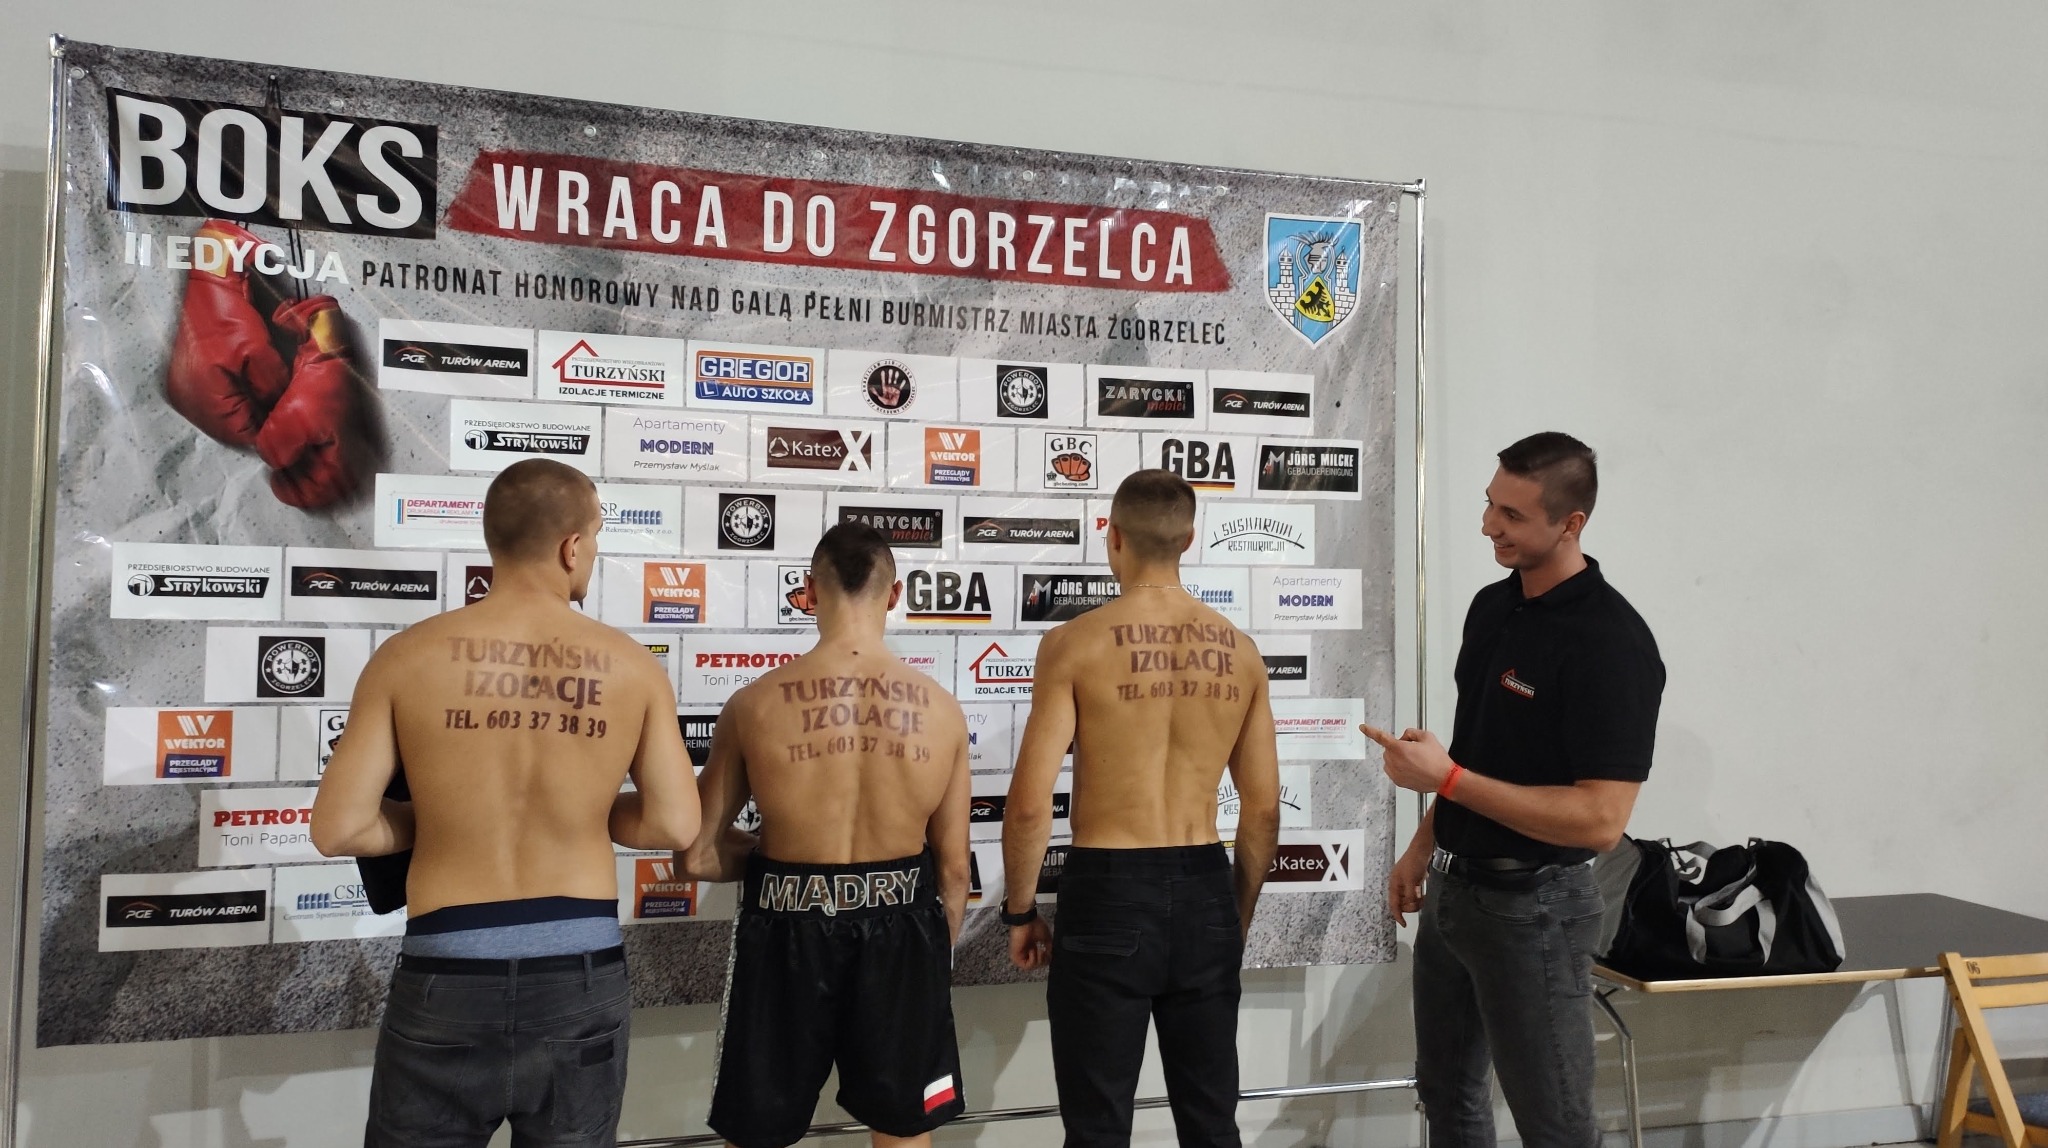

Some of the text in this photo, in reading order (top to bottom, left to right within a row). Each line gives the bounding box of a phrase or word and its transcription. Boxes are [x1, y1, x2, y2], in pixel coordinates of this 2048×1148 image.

[115, 95, 424, 229] BOKS
[492, 163, 1193, 285] WRACA DO ZGORZELCA
[125, 232, 350, 285] II EDYCJA
[362, 260, 502, 296] PATRONAT
[515, 272, 660, 308] HONOROWY
[671, 285, 720, 313] NAD
[732, 289, 792, 322] GALĄ
[804, 293, 870, 323] PEŁNI
[882, 300, 1009, 333] BURMISTRZ
[1020, 310, 1097, 339] MIASTA
[400, 353, 521, 370] PGE TURÓW ARENA
[700, 357, 810, 382] GREGOR
[571, 364, 665, 382] TURZYŃSKI
[1003, 371, 1042, 390] POWERBOX
[559, 387, 665, 400] IZOLACJE TERMICZNE
[722, 387, 811, 402] AUTO SZKOŁA
[1105, 385, 1182, 402] ZARYCKI
[1225, 400, 1305, 411] PGE TURÓW ARENA
[542, 423, 592, 432] BUDOWLANE
[633, 417, 726, 435] Apartamenty
[640, 438, 714, 455] MODERN
[792, 440, 842, 458] Katex
[1050, 437, 1092, 455] GBC
[930, 451, 975, 462] WEKTOR
[1161, 438, 1235, 480] GBA
[1287, 451, 1354, 467] JÖRG MILCKE
[633, 461, 720, 473] Przemysław Myślak
[407, 499, 475, 509] DEPARTAMENT
[600, 502, 619, 517] SR
[726, 500, 769, 519] POWERBOX
[976, 527, 1075, 539] PGE TURÓW ARENA
[215, 565, 270, 574] BUDOWLANE
[309, 579, 430, 593] PGE TURÓW ARENA
[1054, 579, 1121, 596] JÖRG MILCK
[1273, 575, 1342, 588] Apartamenty
[650, 587, 701, 598] WEKTOR
[906, 569, 992, 612] GBA
[1279, 594, 1334, 607] MODERN
[1110, 618, 1236, 649] TURZYŃSKI
[266, 643, 319, 663] POWERBOX
[447, 636, 612, 673] TURZYŃSKI
[695, 653, 803, 668] PETROTO
[985, 665, 1032, 677] TURZY
[1130, 649, 1234, 678] IZOLACJE
[1273, 666, 1303, 675] ARENA
[271, 676, 314, 690] ZGORZELEC
[702, 674, 729, 686] Toni
[464, 669, 603, 710] IZOLACJE
[778, 672, 929, 709] TURZYŃSKI
[1116, 680, 1240, 703] TEL. 603 37 38 39
[444, 708, 607, 739] TEL. 603 37 38 39
[801, 703, 925, 738] IZOLACJE
[686, 723, 715, 738] MILC
[164, 738, 226, 750] WEKTOR
[787, 735, 931, 764] TEL. 603 37 38 39
[213, 808, 312, 828] PETROT
[971, 807, 991, 817] PGE
[221, 833, 253, 847] Toni
[1043, 850, 1065, 867] JÖR
[1279, 856, 1324, 870] Katex
[334, 884, 366, 900] CSR
[640, 882, 692, 893] WEKTOR
[125, 904, 257, 920] PGE TURÓW ARENA
